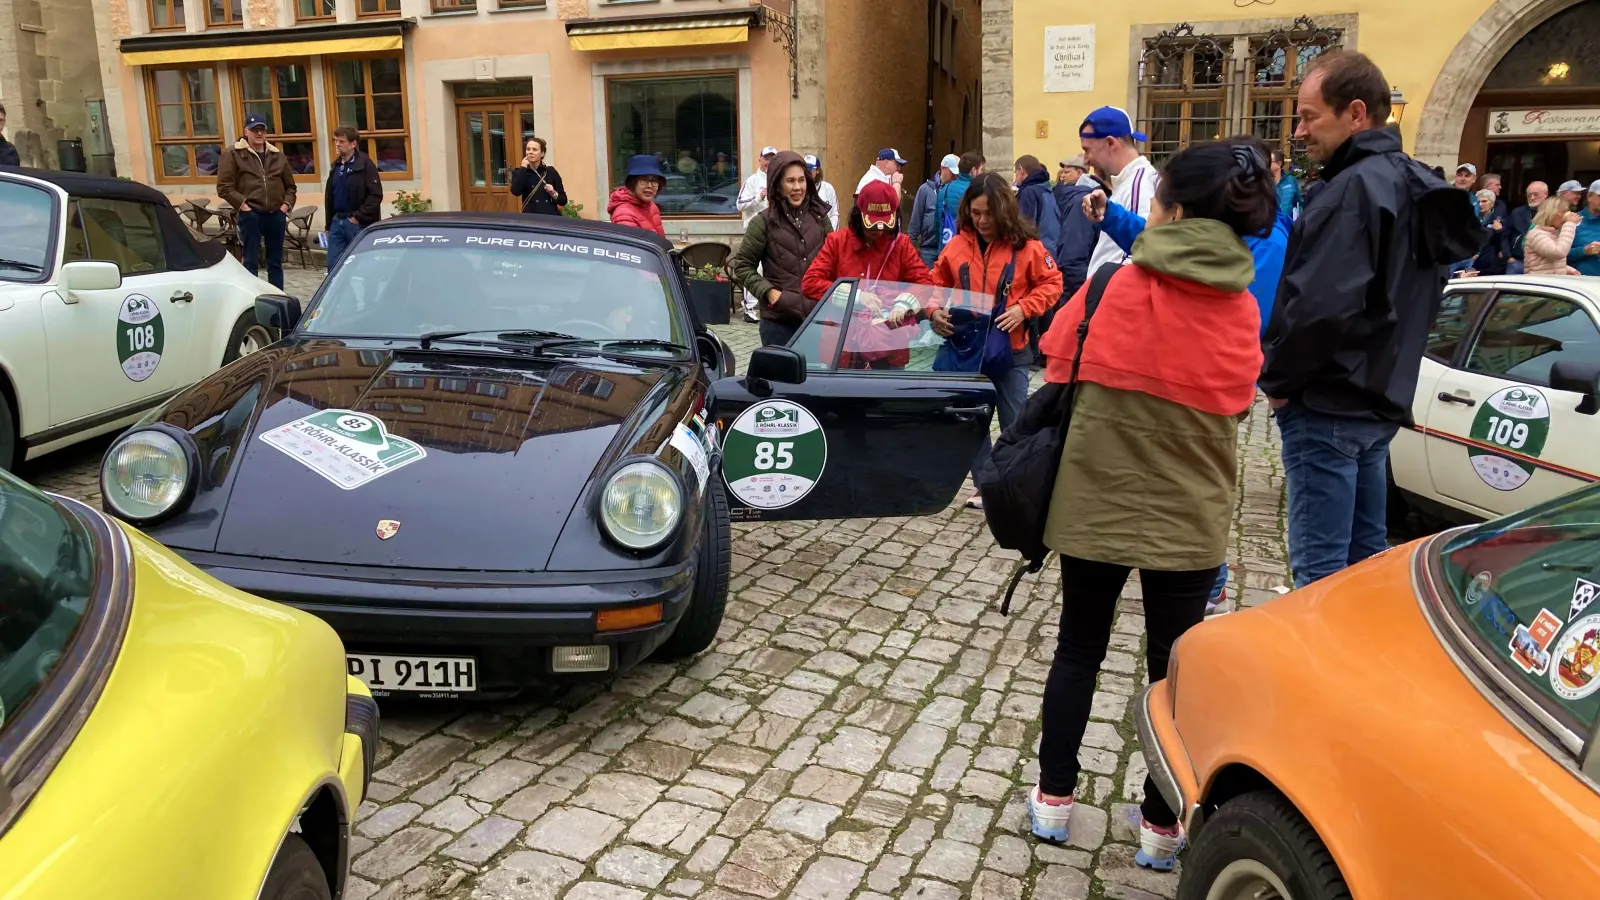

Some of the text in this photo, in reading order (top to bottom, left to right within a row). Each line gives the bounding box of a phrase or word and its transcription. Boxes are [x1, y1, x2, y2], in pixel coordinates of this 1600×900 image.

[1054, 52, 1081, 61] Christian
[465, 236, 642, 264] PURE DRIVING BLISS
[126, 325, 155, 351] 108
[342, 418, 366, 429] 85
[1486, 416, 1529, 449] 109
[754, 441, 795, 470] 85
[394, 660, 473, 687] 911H
